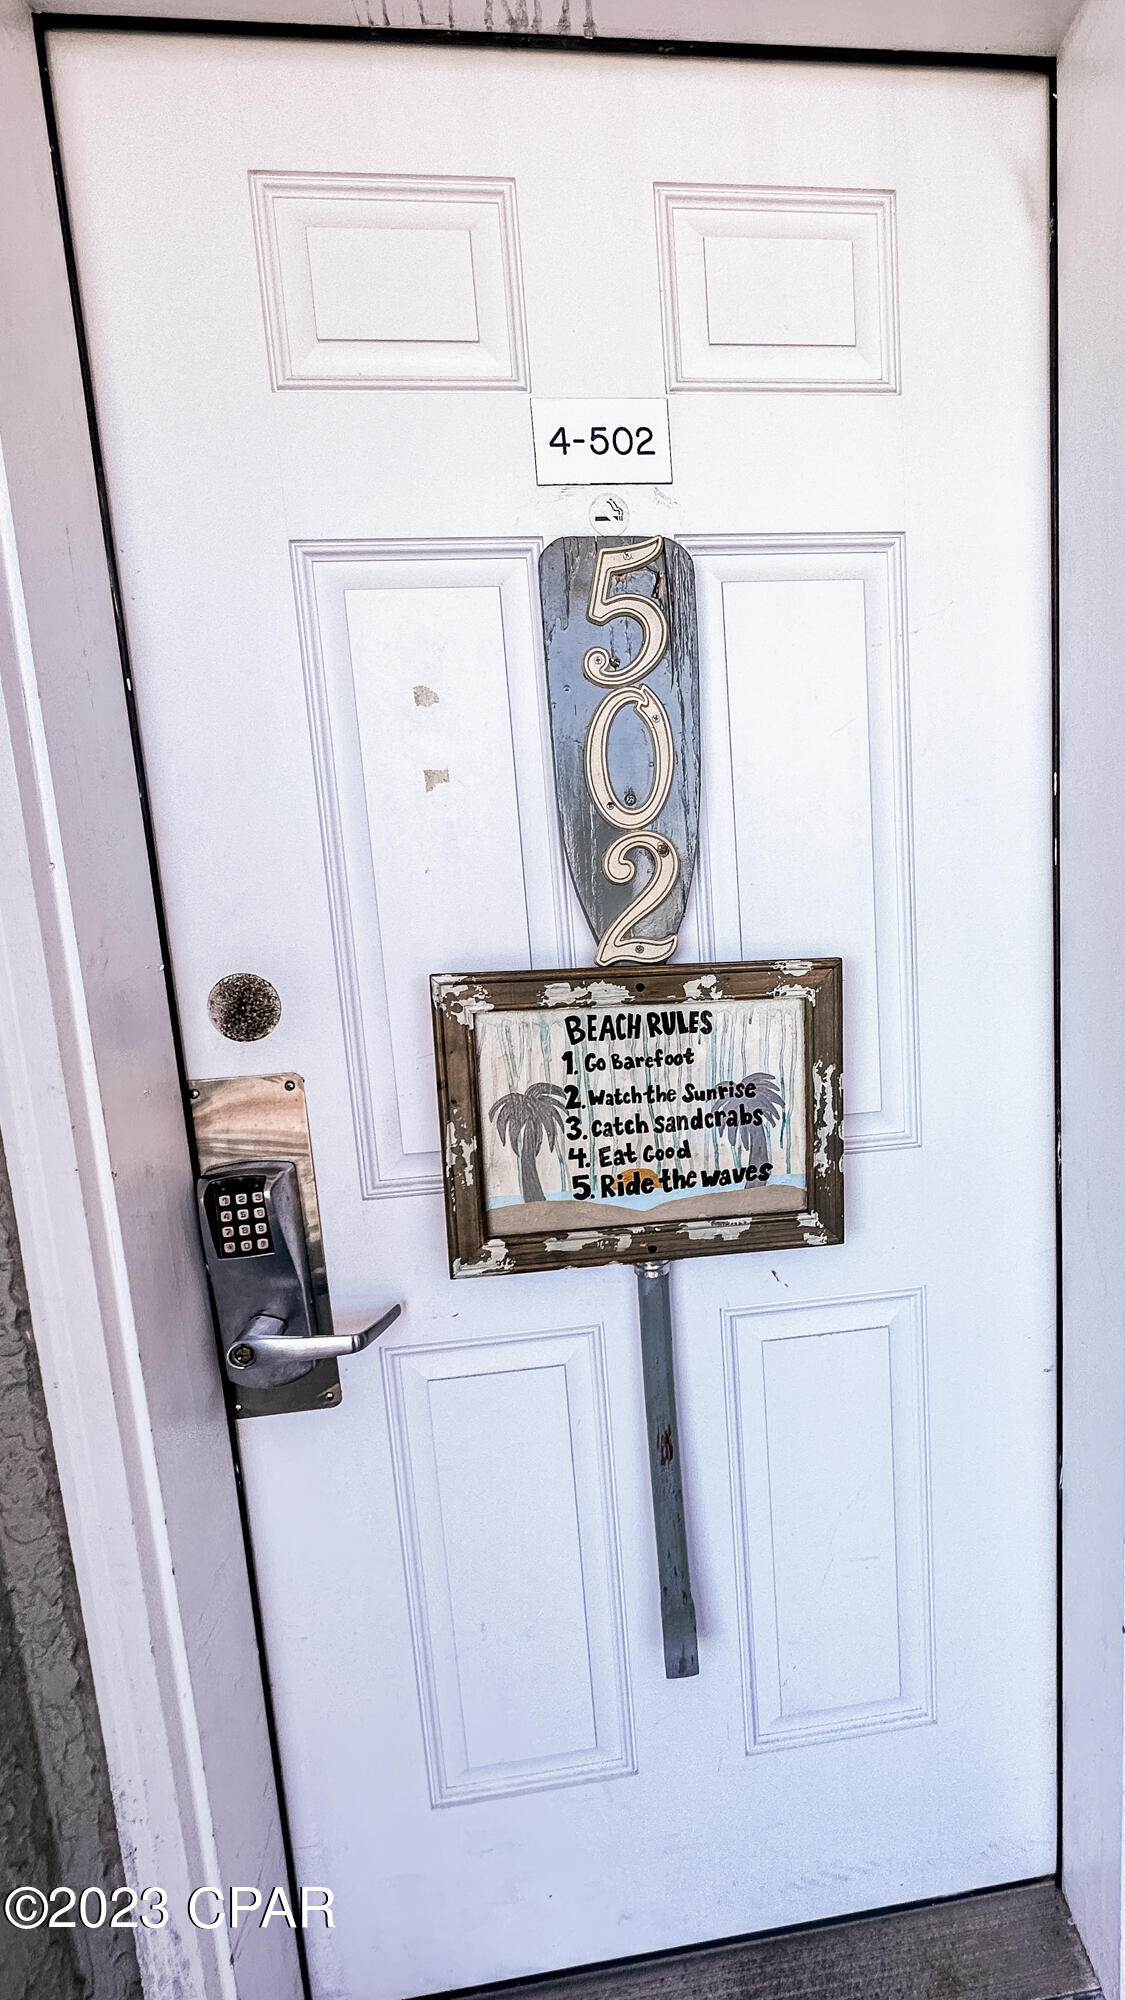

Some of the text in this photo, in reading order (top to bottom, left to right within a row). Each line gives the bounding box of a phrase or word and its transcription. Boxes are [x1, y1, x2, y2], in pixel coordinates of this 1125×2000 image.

[550, 427, 656, 455] 4-502
[565, 1010, 713, 1045] BEACH RULES
[562, 1048, 695, 1075] 1. Go Barefoot
[564, 1081, 757, 1109] 2. Watch the Sunrise
[566, 1116, 588, 1140] 3.
[568, 1140, 692, 1168] 4. Eat Good
[572, 1174, 595, 1200] 5.
[601, 1172, 654, 1198] Ride
[659, 1168, 697, 1192] the
